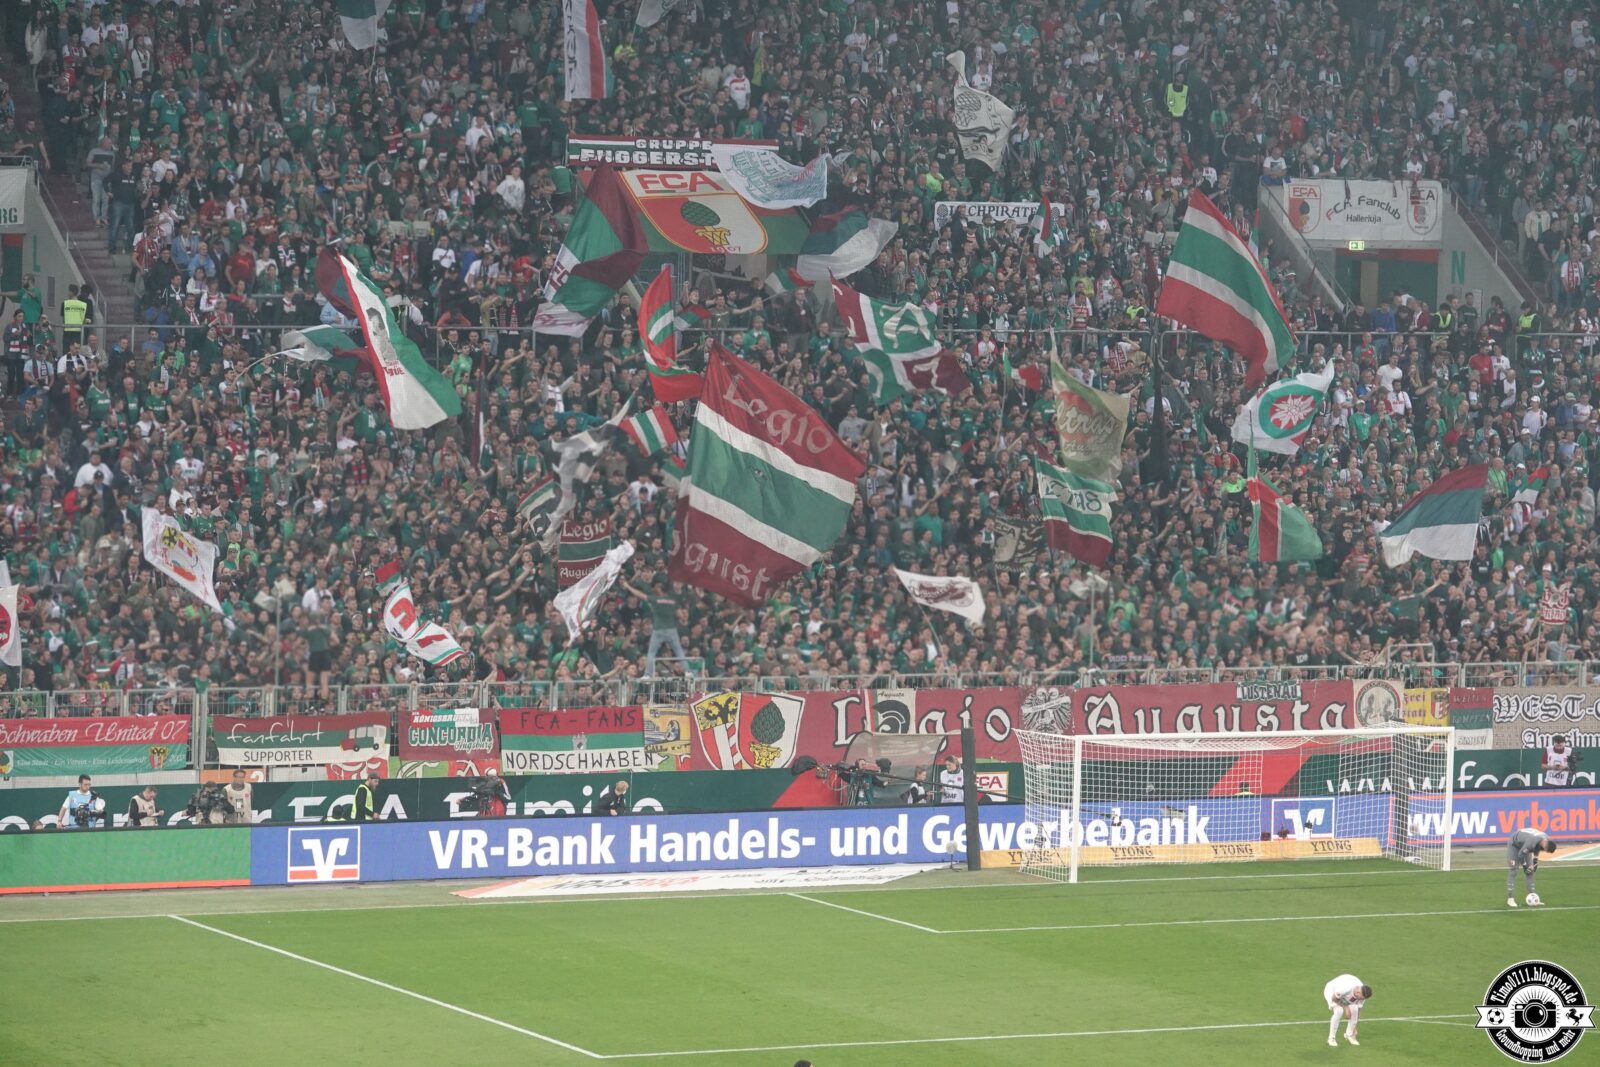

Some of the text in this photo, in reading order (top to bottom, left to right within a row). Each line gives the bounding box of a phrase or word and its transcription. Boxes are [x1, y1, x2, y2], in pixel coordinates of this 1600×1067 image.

[635, 138, 713, 150] GRUPPE
[580, 149, 713, 167] FUGGERST
[636, 171, 724, 192] FCA
[1292, 186, 1318, 198] FCA
[949, 204, 1040, 218] LCHPIRATE
[1357, 195, 1401, 221] Fanclub
[1452, 251, 1466, 284] N
[722, 374, 834, 454] Legio
[1056, 399, 1116, 434] ltras
[562, 519, 607, 541] Legio
[1240, 682, 1301, 701] LUSTENAU
[520, 711, 561, 730] FCA
[587, 708, 638, 728] FANS
[1084, 690, 1348, 733] Augusta
[0, 719, 187, 745] Schwaben United 07
[408, 723, 493, 746] CONCORDIA
[832, 696, 1013, 752] Lgio
[243, 750, 313, 762] SUPPORTER
[505, 750, 654, 770] NORDSCHWABEN
[428, 805, 1211, 870] VR-Bank Handels- und Gewerbebank
[1310, 839, 1352, 852] YTONG
[1008, 850, 1052, 864] YTONG
[1109, 845, 1154, 858] YTONG
[1211, 843, 1254, 856] YTONG
